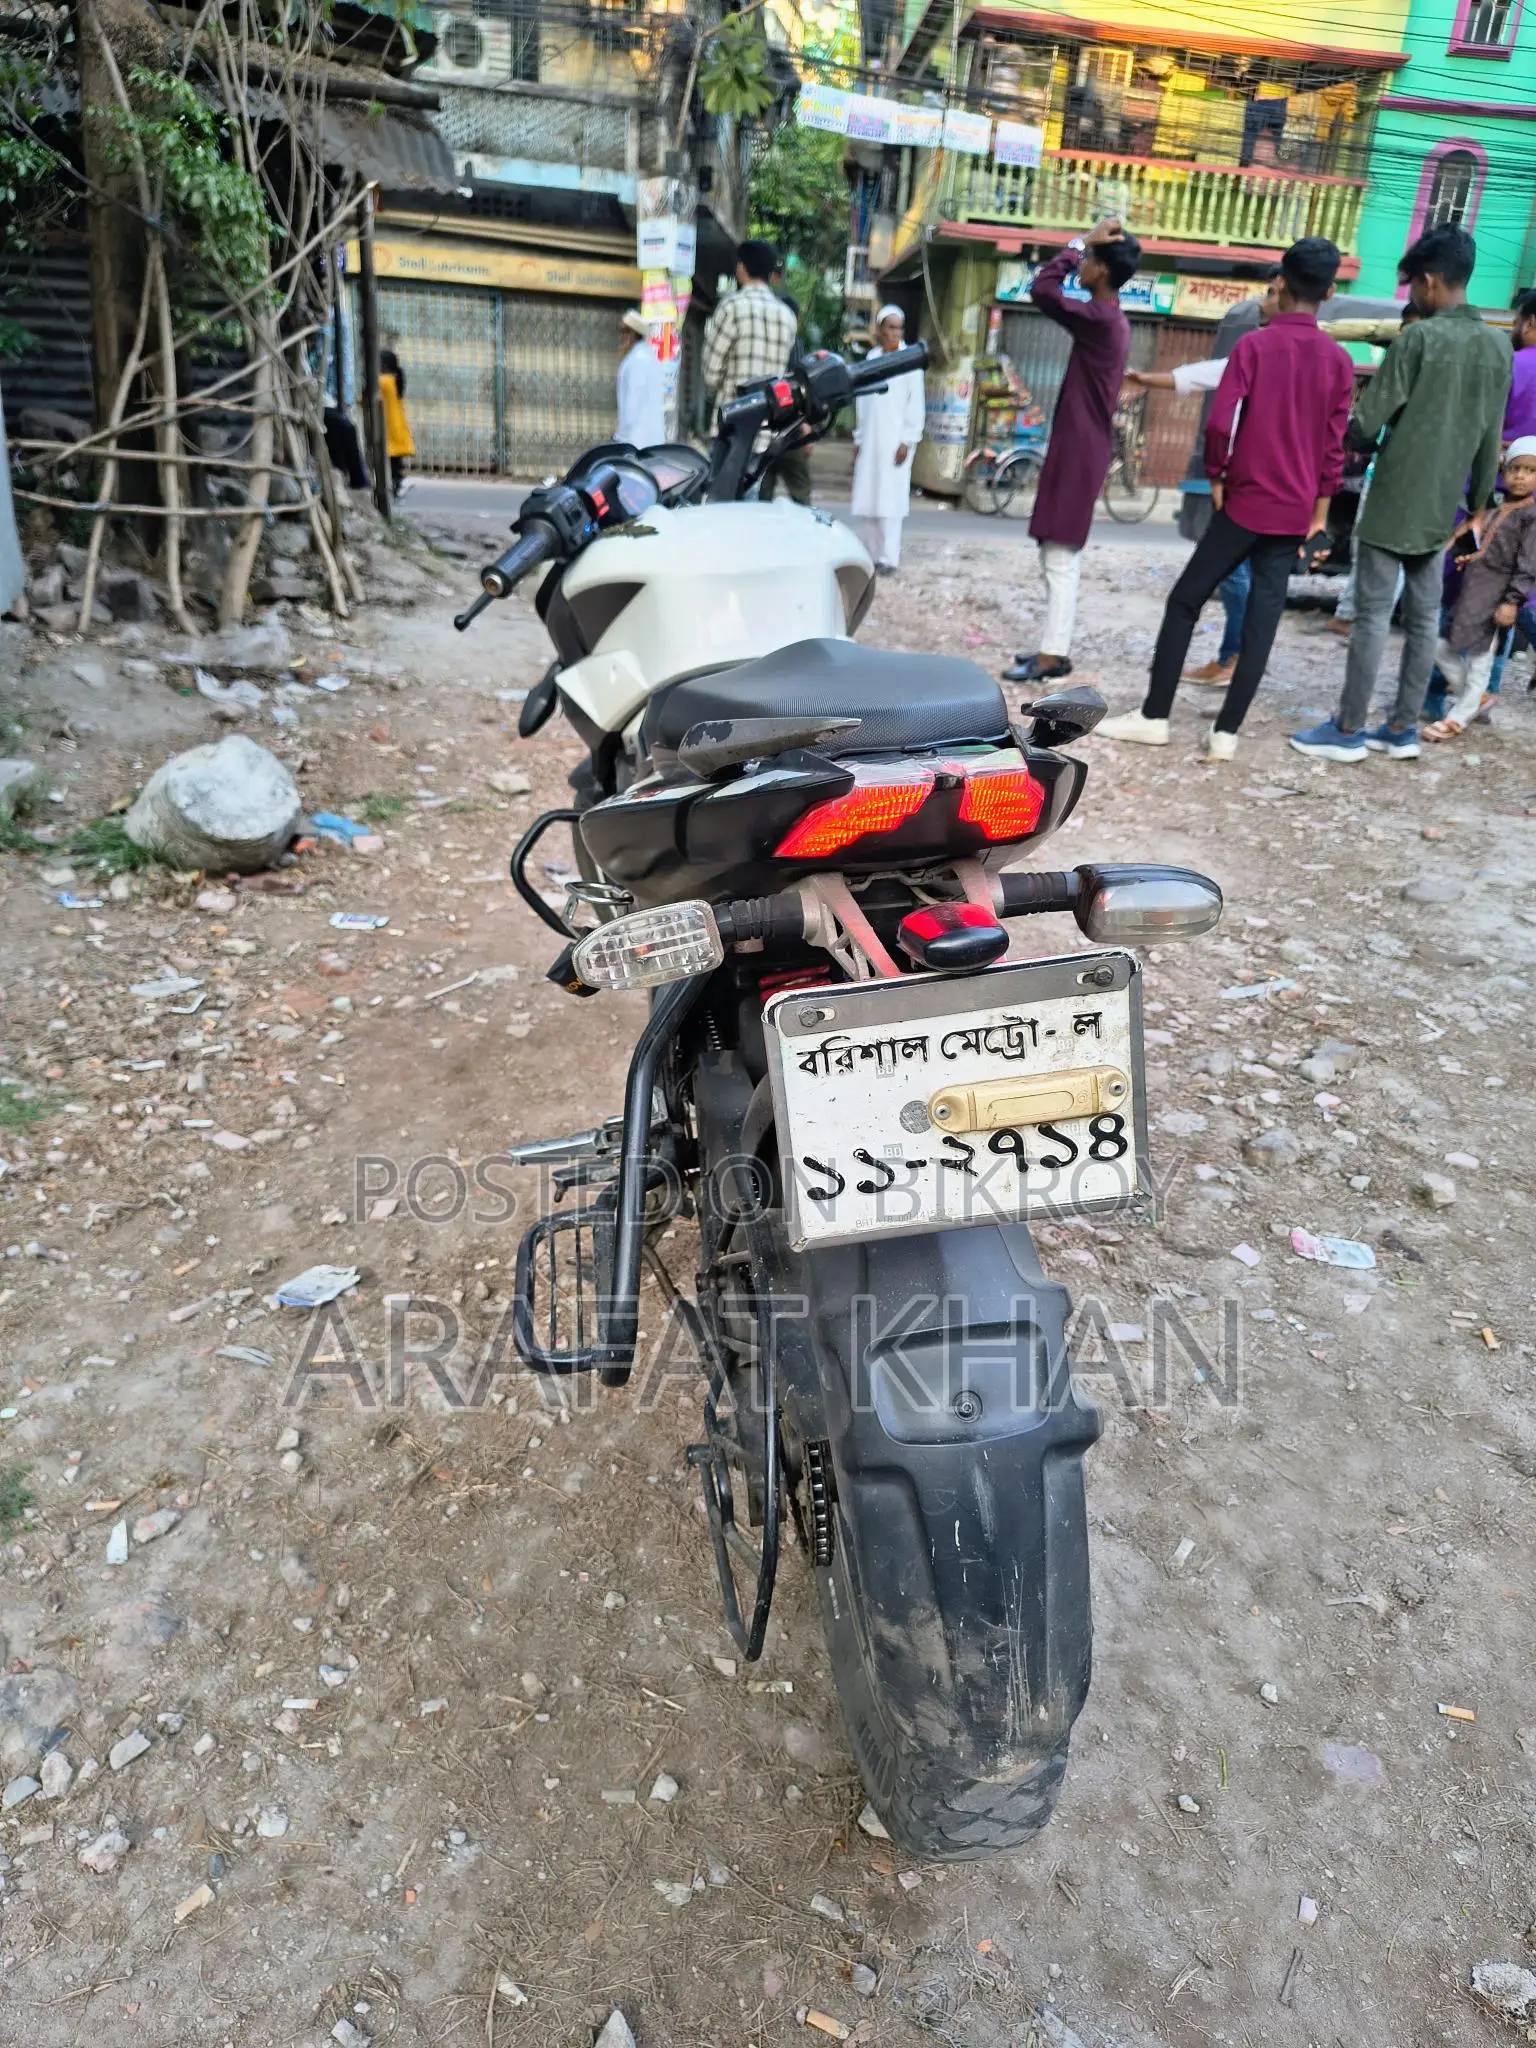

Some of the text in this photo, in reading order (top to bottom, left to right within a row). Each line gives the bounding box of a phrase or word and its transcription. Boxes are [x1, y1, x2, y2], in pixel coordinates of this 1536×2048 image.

[797, 1035, 929, 1077] বরিশাল
[940, 1014, 1039, 1060] মেট্রো
[1073, 1011, 1103, 1039] ল
[802, 1112, 1129, 1201] ১১-২৭১৪
